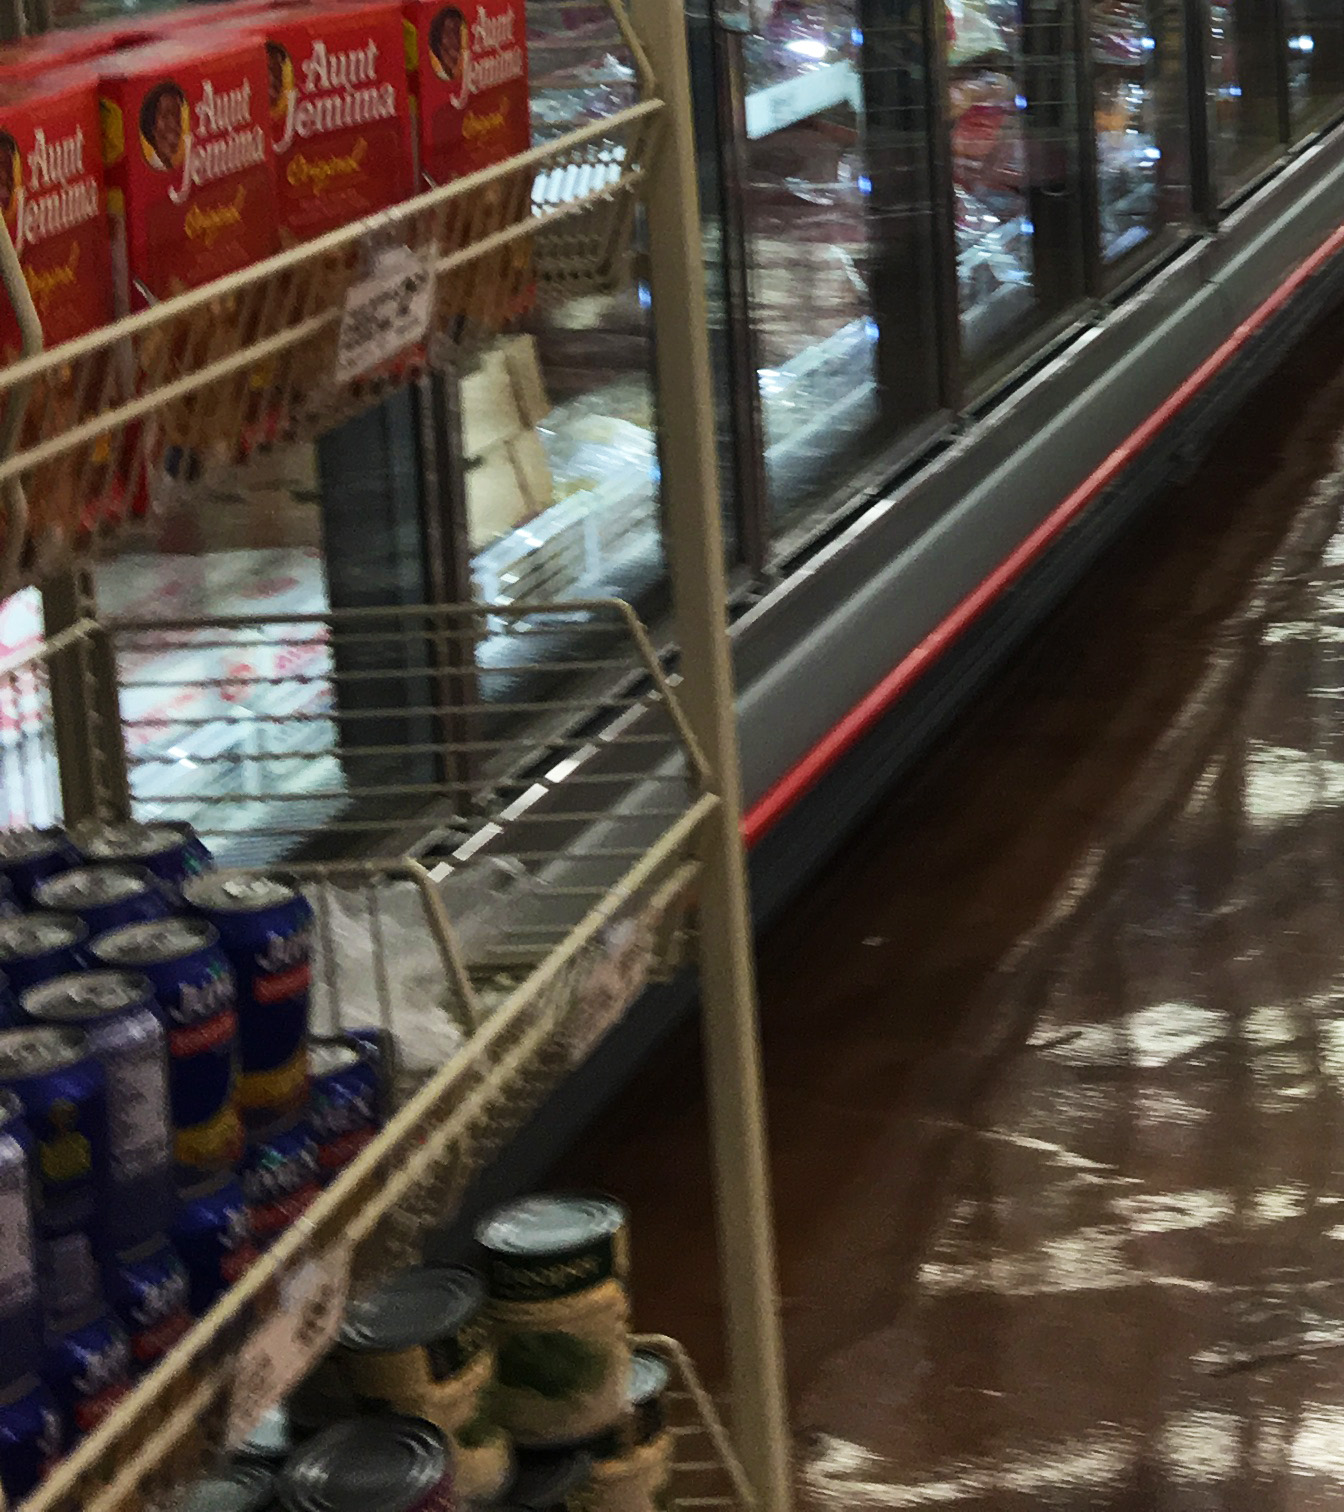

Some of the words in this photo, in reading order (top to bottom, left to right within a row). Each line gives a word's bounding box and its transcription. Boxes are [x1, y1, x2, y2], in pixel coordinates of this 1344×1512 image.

[470, 2, 516, 54] Aunt
[301, 38, 378, 94] Aunt
[449, 45, 524, 110] Jemima
[195, 77, 252, 136] Aunt
[272, 82, 397, 156] Jemima
[27, 123, 85, 192] Aunt
[168, 124, 266, 205] Jemima
[14, 174, 100, 262] Jemima
